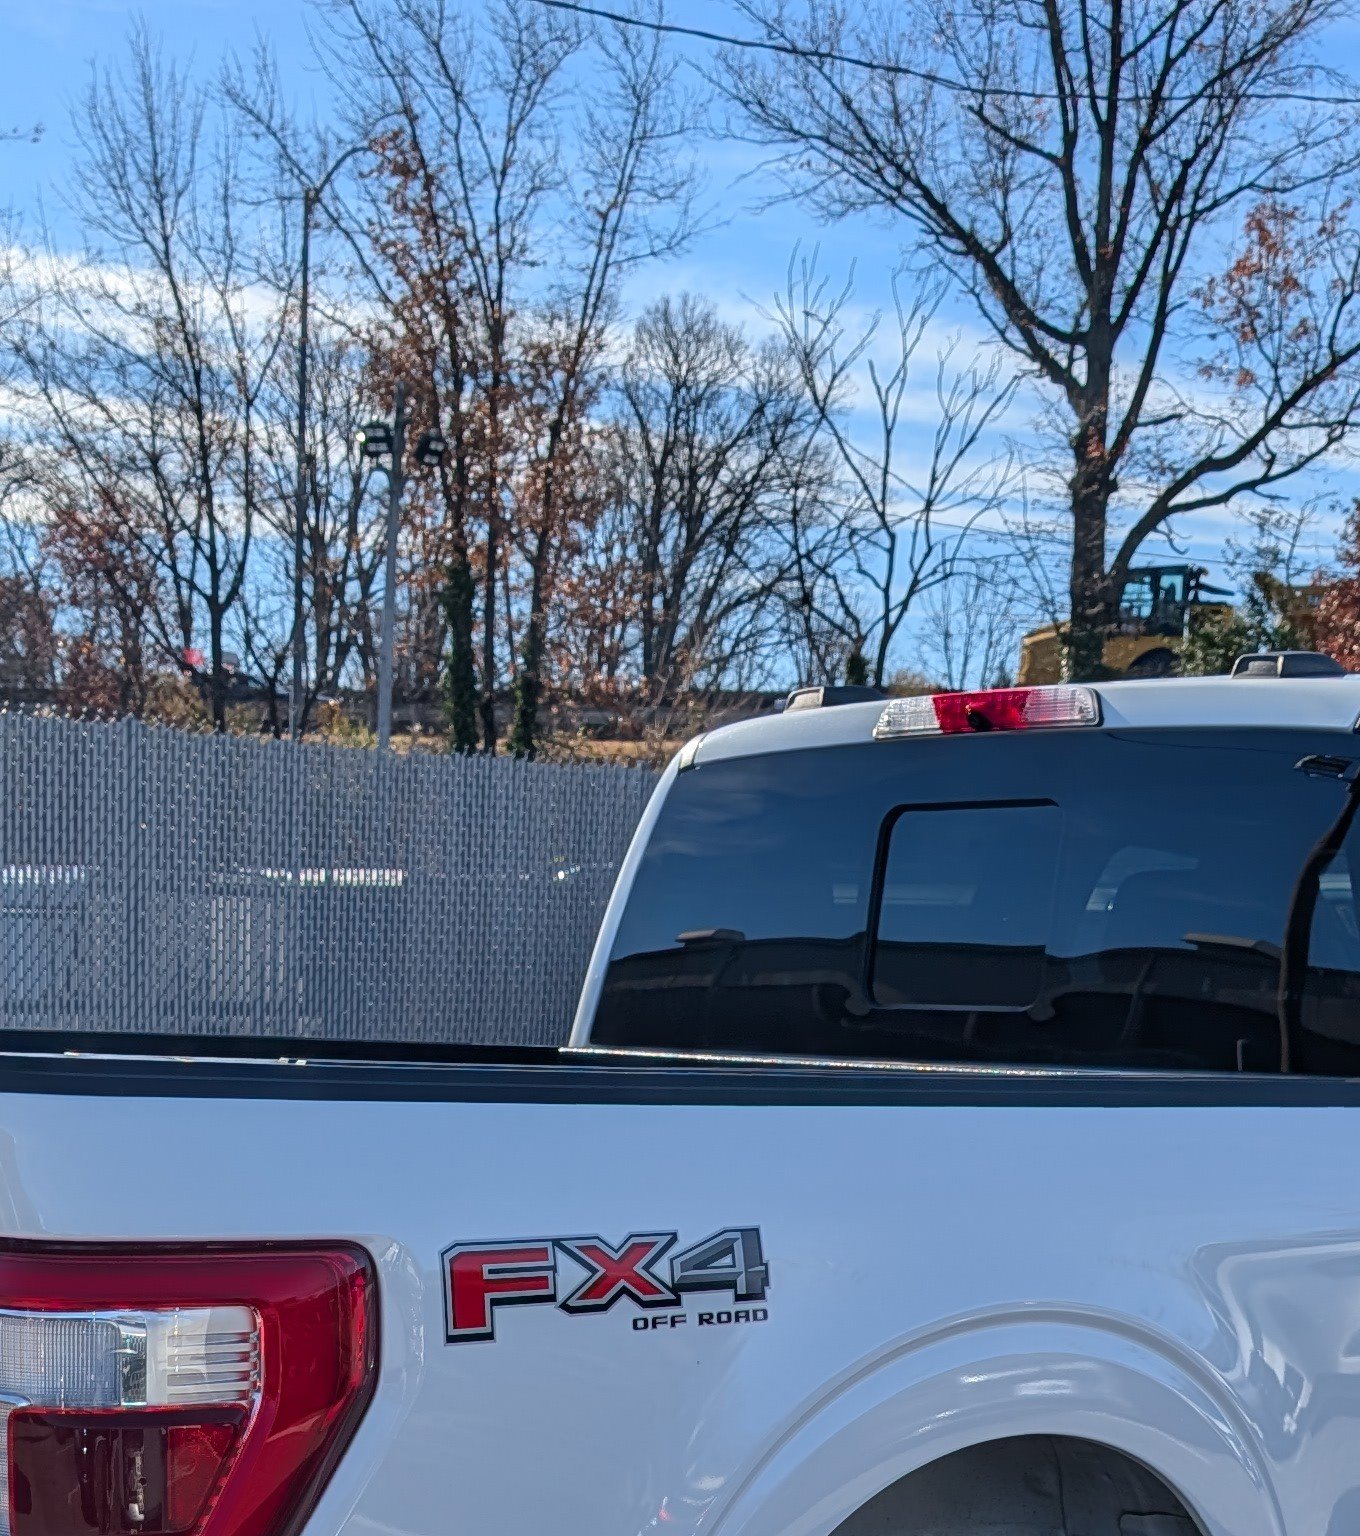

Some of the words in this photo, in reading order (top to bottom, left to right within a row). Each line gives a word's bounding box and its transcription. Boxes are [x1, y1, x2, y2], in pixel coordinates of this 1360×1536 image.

[440, 1224, 771, 1346] FX4
[632, 1312, 687, 1331] OFF
[697, 1307, 769, 1327] ROAD
